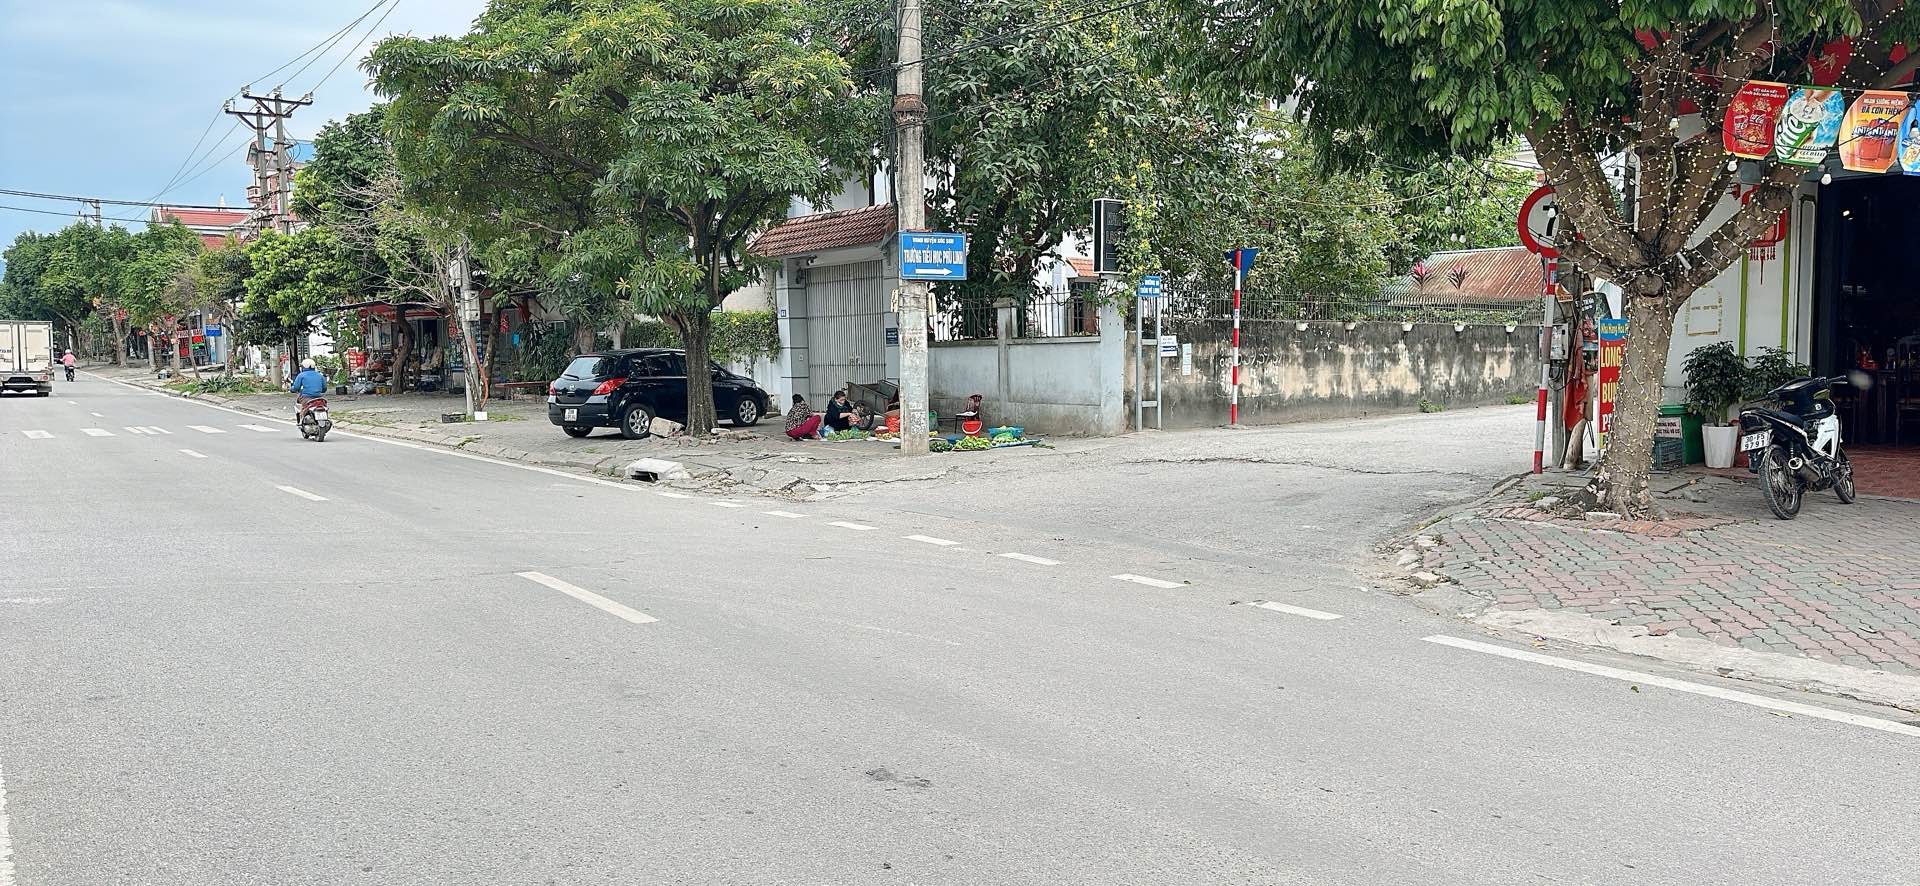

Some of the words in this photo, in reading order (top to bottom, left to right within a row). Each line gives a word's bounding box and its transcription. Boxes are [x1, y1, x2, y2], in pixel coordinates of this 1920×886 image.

[904, 246, 922, 264] TRƯỜNG
[922, 244, 932, 264] TIỂU
[933, 249, 942, 267] HỌC
[943, 247, 953, 264] PHÙ
[953, 250, 963, 264] LINH
[1601, 341, 1622, 368] LÒNG
